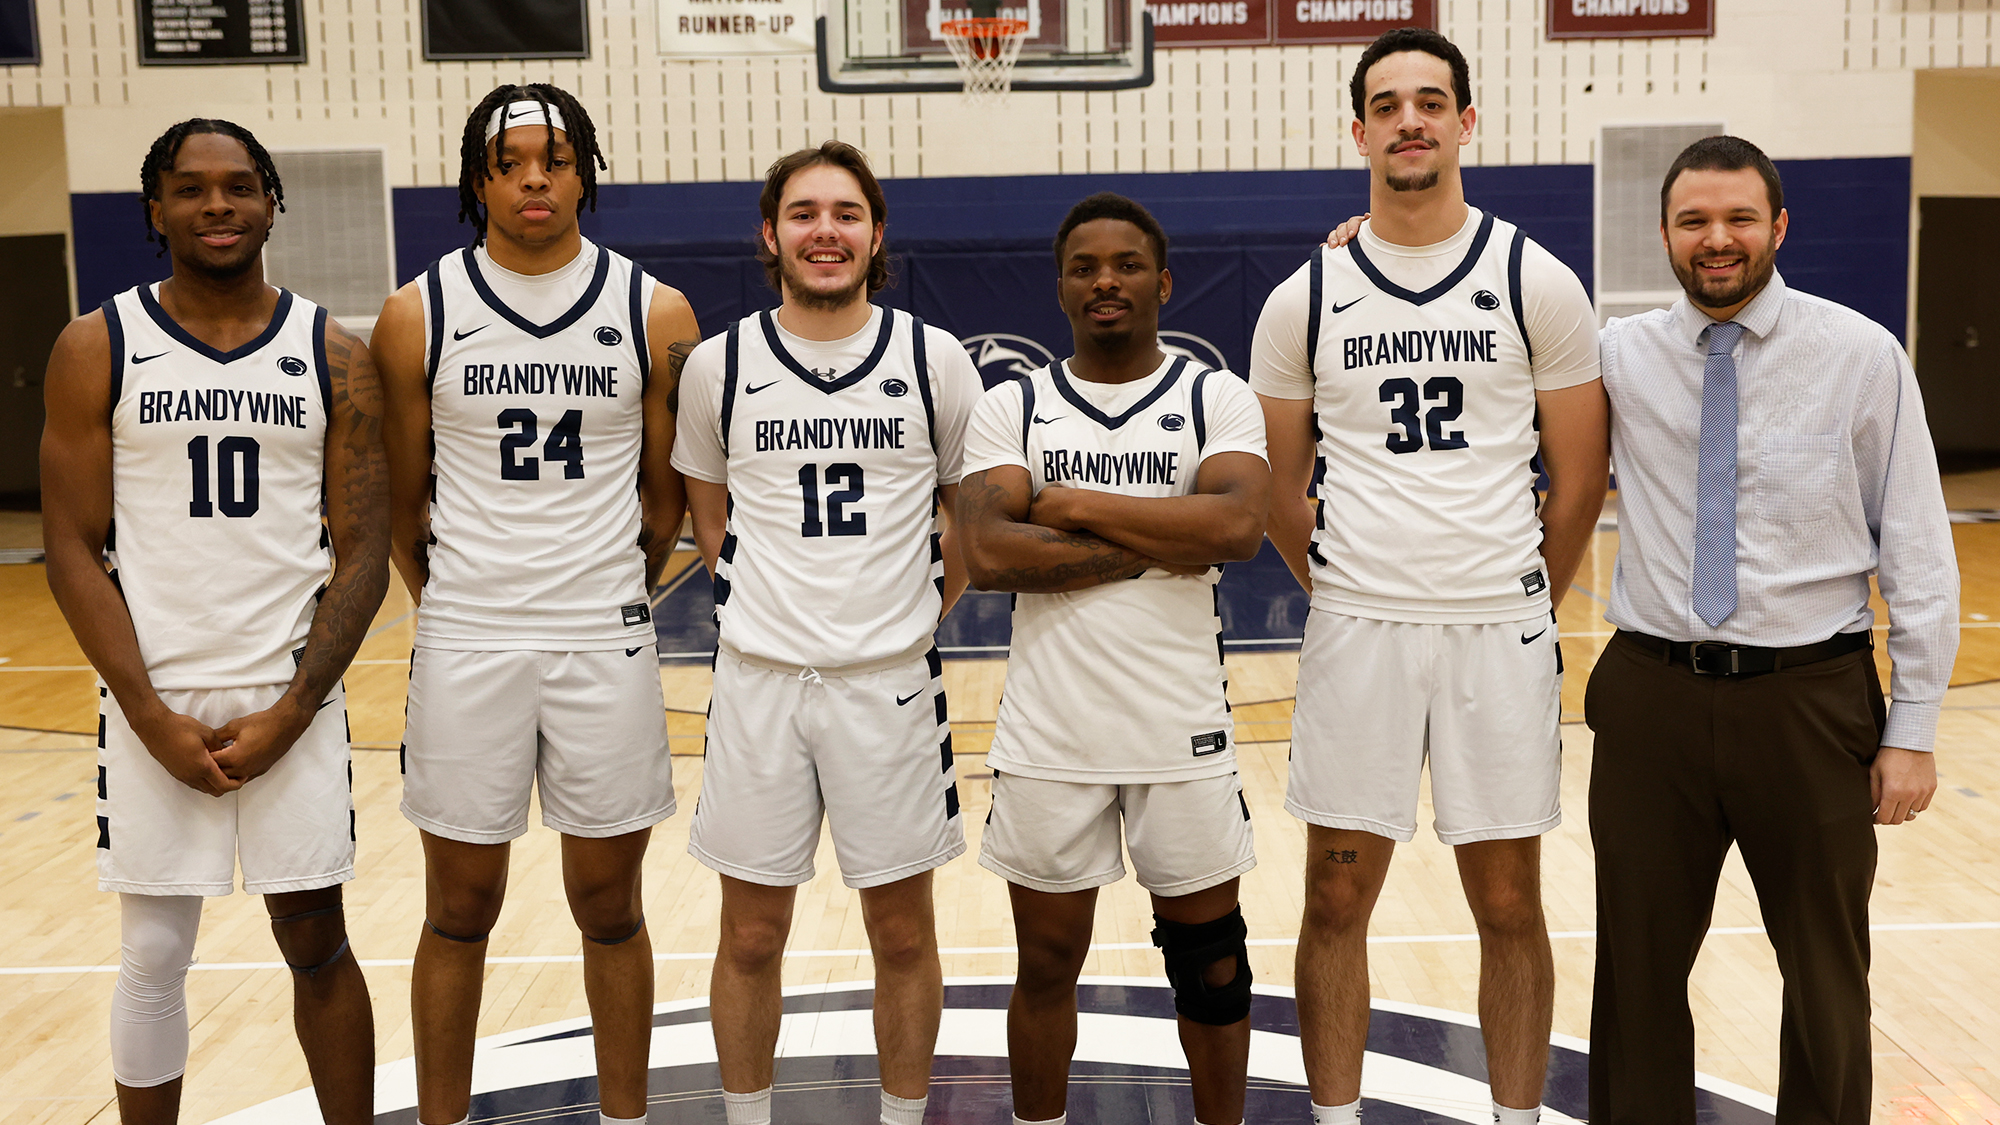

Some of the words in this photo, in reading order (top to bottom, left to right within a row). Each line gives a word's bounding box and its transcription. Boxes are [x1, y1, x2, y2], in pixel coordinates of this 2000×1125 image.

[678, 15, 794, 34] RUNNER-UP
[1146, 1, 1248, 26] HAMPIONS
[1296, 0, 1414, 23] CHAMPIONS
[1572, 0, 1689, 17] CHAMPIONS
[1343, 330, 1498, 370] BRANDYWINE
[463, 363, 618, 398] BRANDYWINE
[139, 388, 307, 429] BRANDYWINE
[1379, 377, 1469, 454] 32
[497, 408, 585, 480] 24
[756, 417, 905, 452] BRANDYWINE
[187, 435, 260, 517] 10
[1043, 449, 1178, 486] BRANDYWINE
[798, 463, 867, 537] 12
[1217, 737, 1223, 746] L
[1325, 848, 1358, 864] 太鼓
